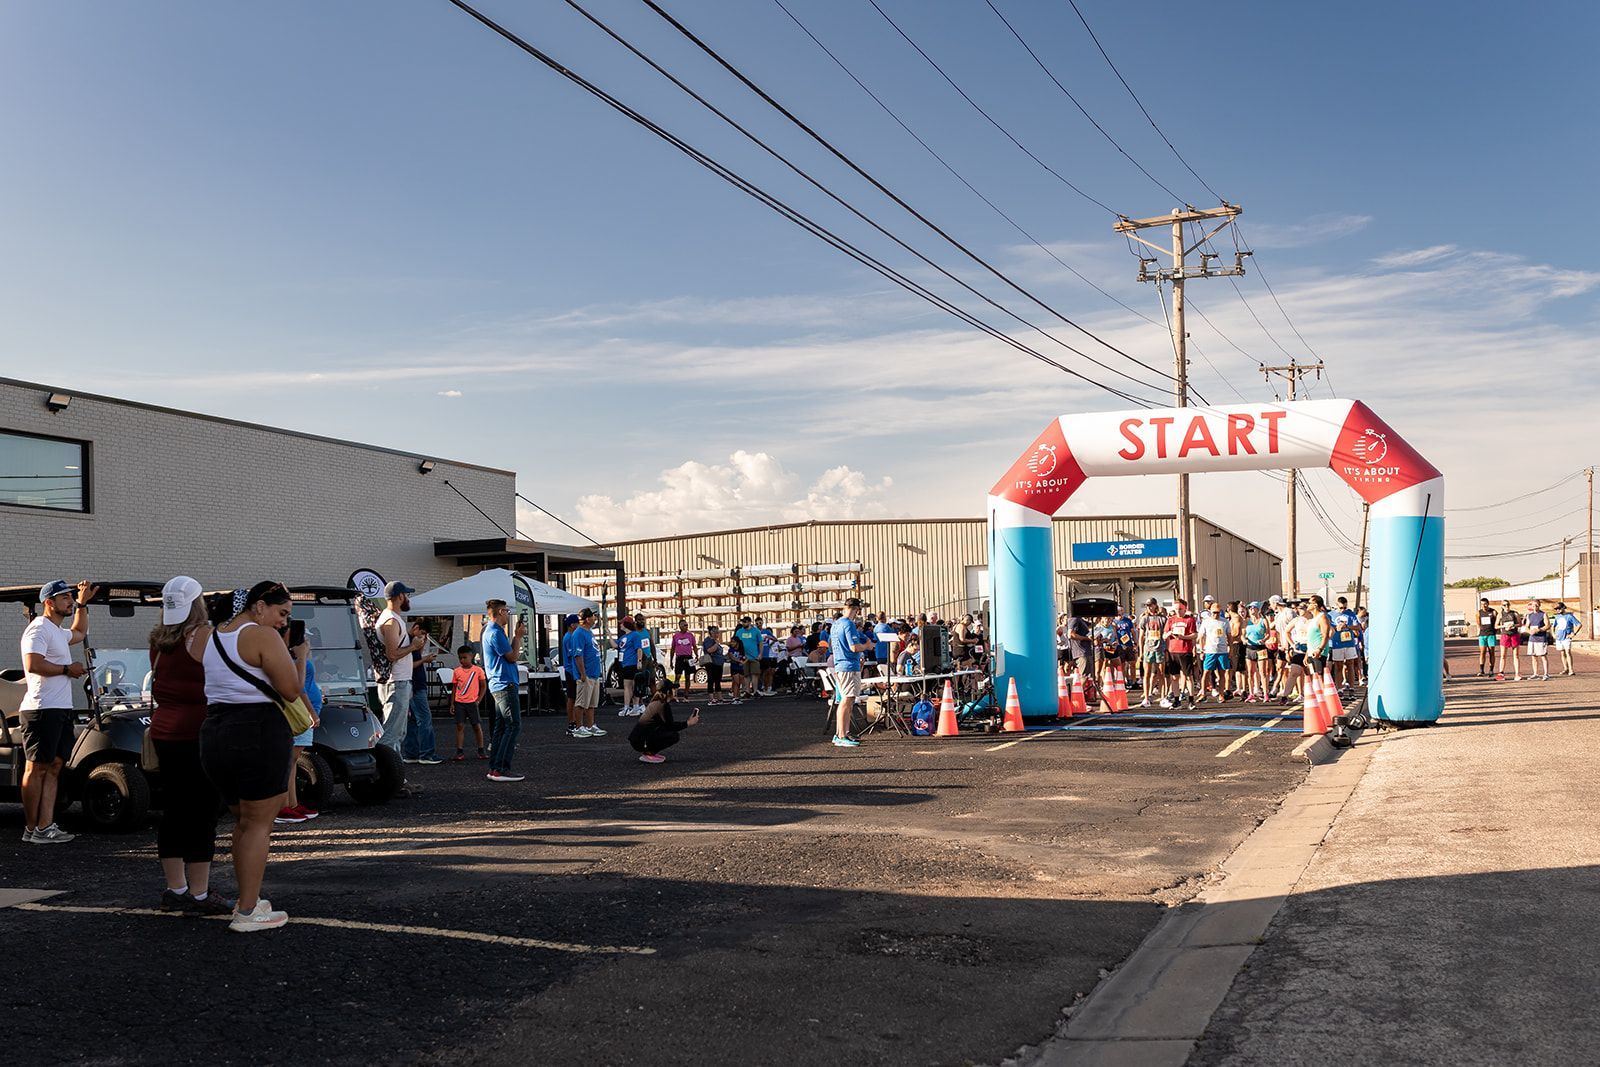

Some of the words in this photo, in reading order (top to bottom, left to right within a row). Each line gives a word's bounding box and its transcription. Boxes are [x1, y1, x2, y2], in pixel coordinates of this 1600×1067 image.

[1118, 411, 1286, 461] START
[1344, 467, 1360, 475] IT'S
[1363, 467, 1400, 476] ABOUT
[1015, 480, 1032, 489] IT'S
[1035, 477, 1068, 488] ABOUT
[1024, 487, 1060, 495] TIMING
